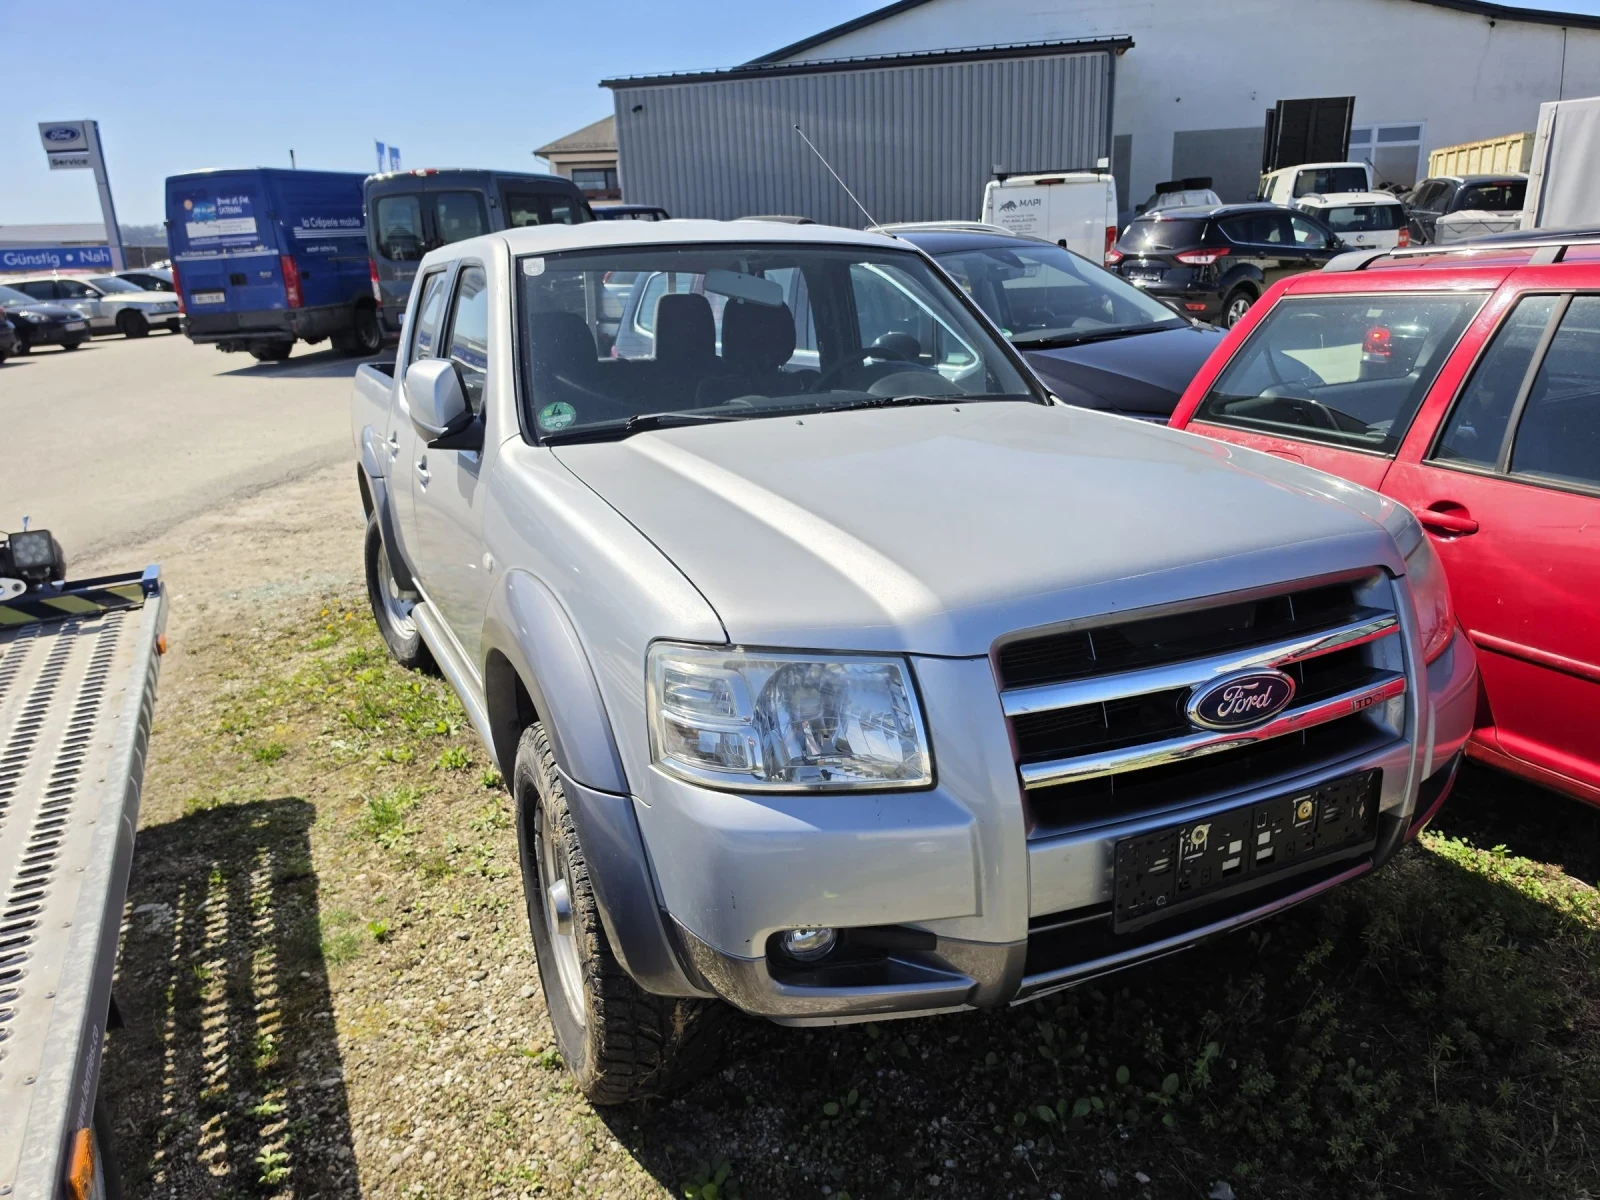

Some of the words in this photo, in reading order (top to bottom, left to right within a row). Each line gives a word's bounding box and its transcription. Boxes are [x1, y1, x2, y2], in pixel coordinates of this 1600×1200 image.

[3, 252, 60, 267] Günstig
[79, 249, 110, 263] Nah
[1217, 682, 1273, 717] Ford
